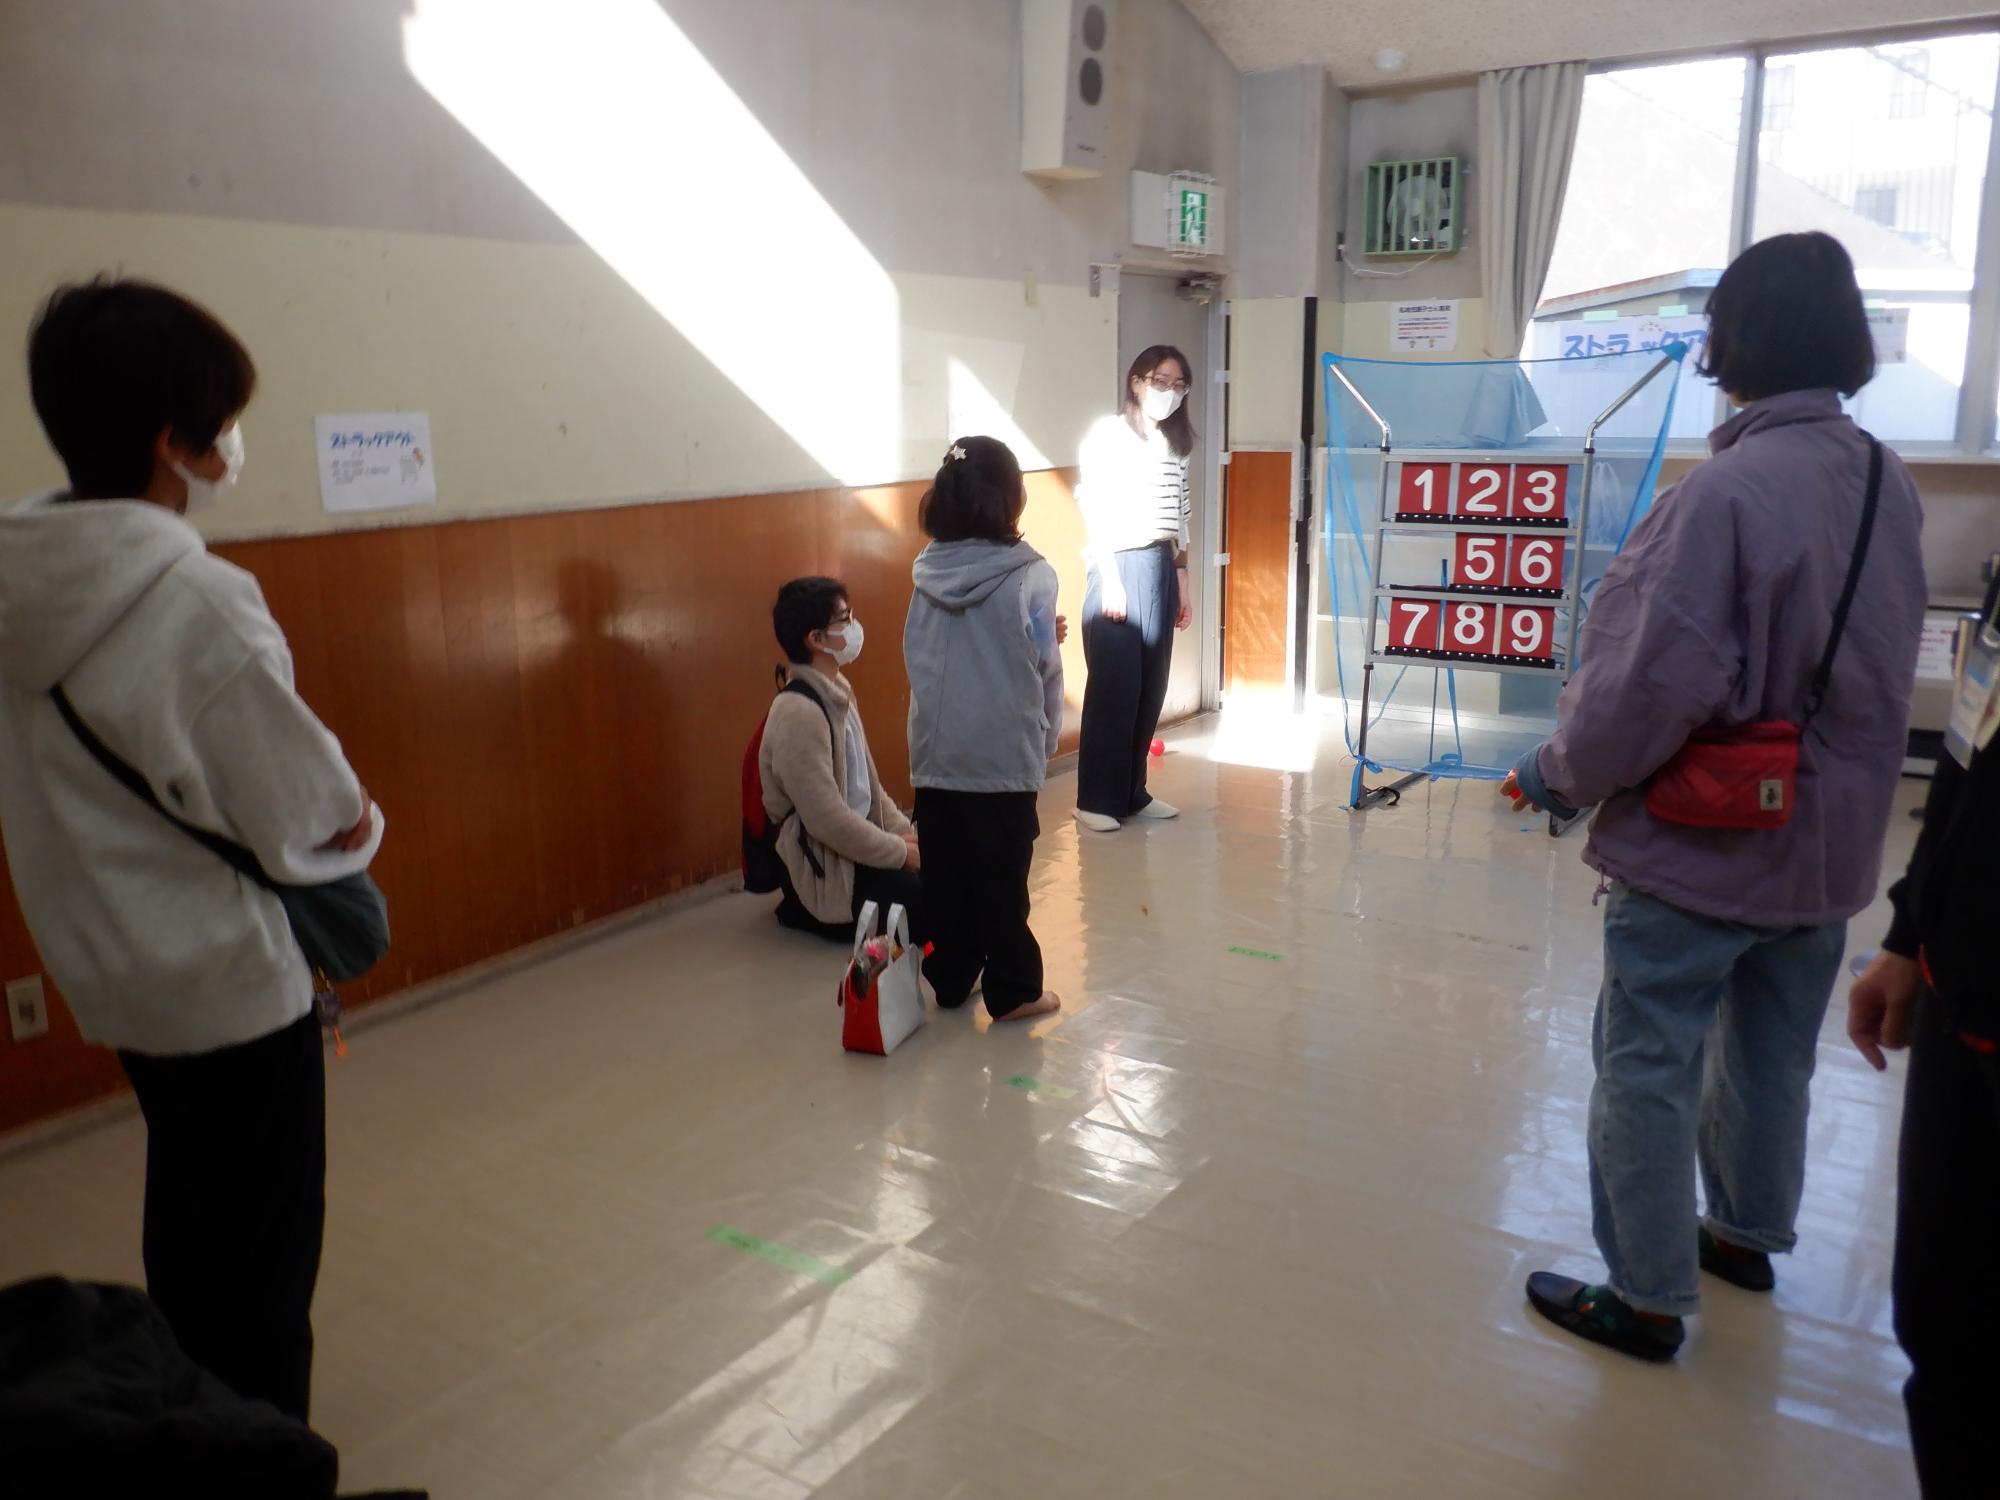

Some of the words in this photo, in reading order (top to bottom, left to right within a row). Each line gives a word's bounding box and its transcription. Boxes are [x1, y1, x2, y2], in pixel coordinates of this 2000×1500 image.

[1414, 469, 1434, 511] 1
[1465, 469, 1501, 512] 2
[1523, 470, 1557, 513] 3
[1464, 538, 1496, 581] 5
[1520, 540, 1553, 584] 6
[1400, 603, 1430, 645] 7
[1454, 602, 1484, 645] 8
[1511, 609, 1543, 653] 9
